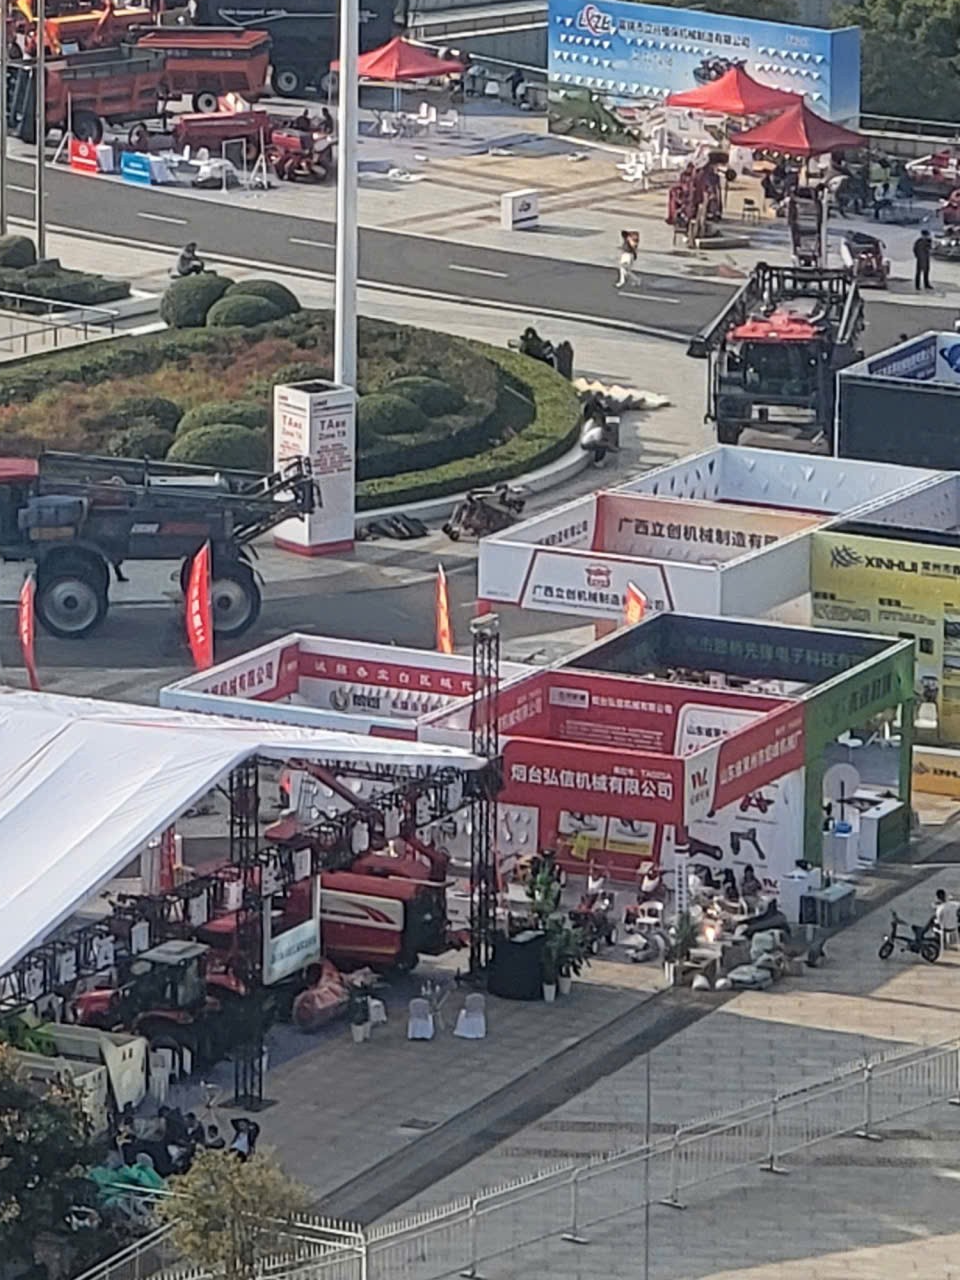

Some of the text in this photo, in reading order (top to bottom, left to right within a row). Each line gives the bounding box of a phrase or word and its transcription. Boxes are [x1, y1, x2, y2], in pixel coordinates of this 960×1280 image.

[531, 583, 665, 611] 广西立创机械制造公司
[510, 763, 674, 800] 烟台弘信机械有限公司
